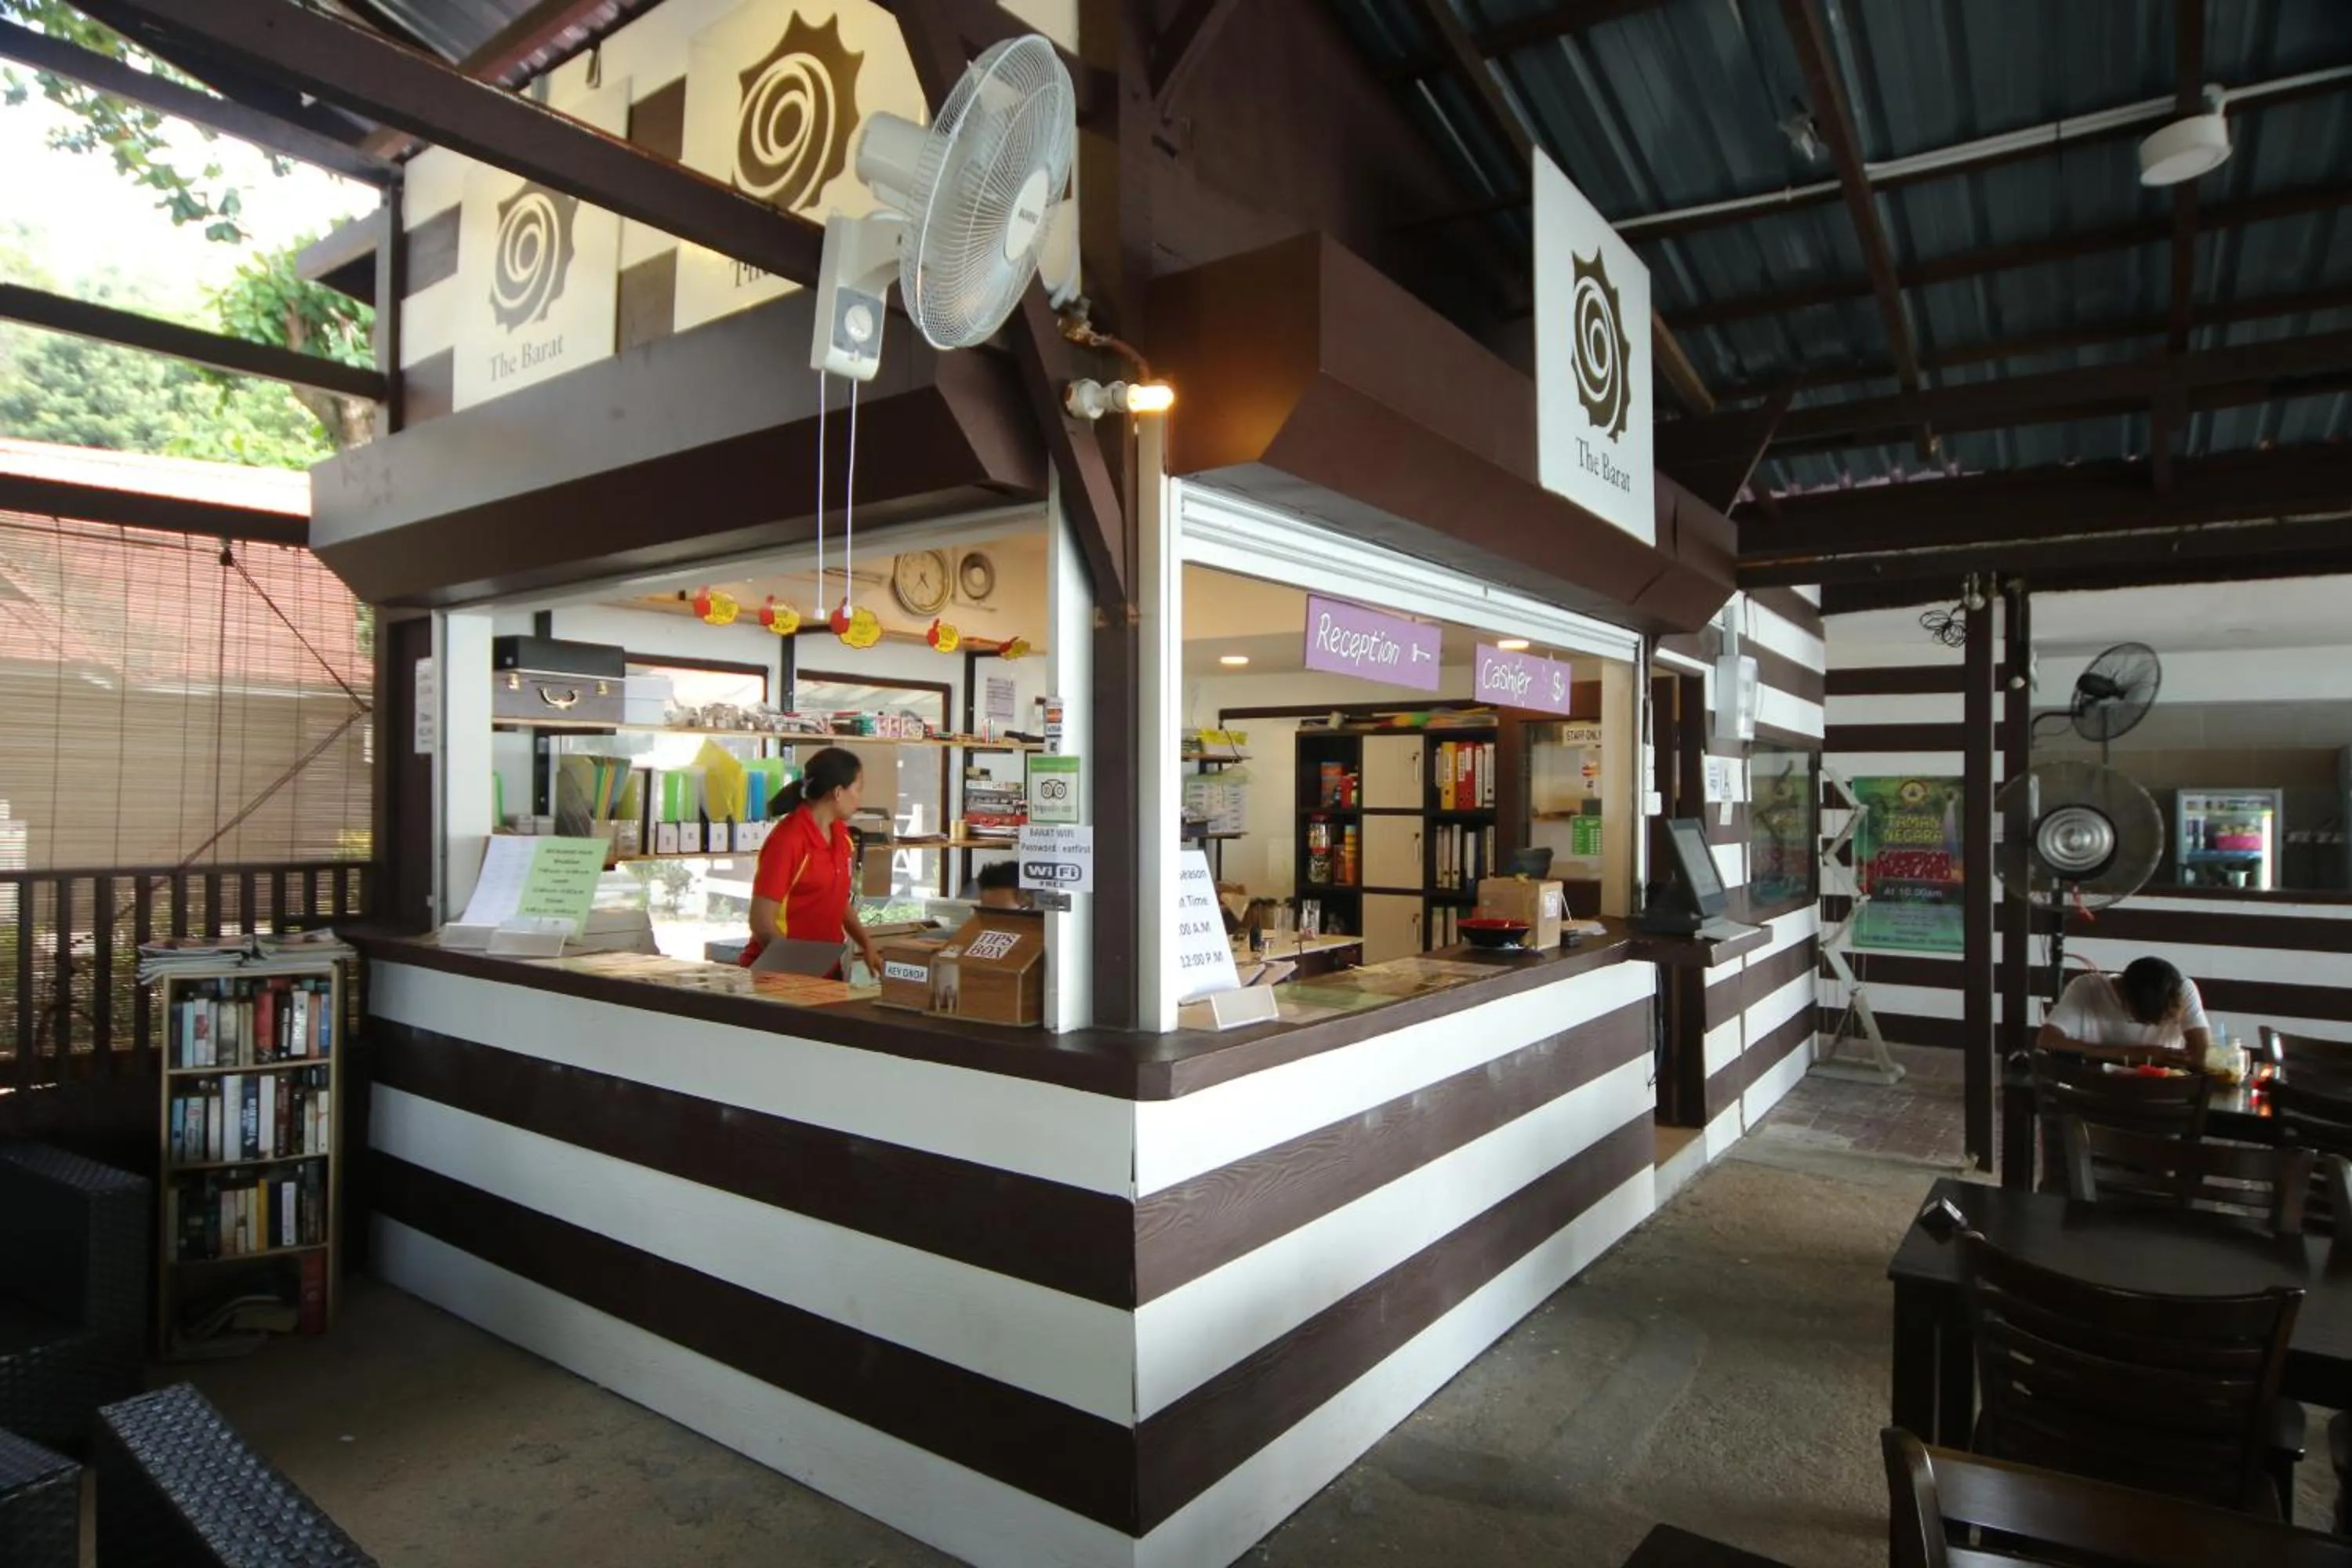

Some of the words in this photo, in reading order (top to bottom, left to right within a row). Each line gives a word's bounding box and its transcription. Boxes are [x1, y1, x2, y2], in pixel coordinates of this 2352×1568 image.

[729, 260, 769, 288] Th
[490, 351, 517, 382] The
[521, 333, 564, 368] Barat
[1575, 436, 1599, 475] The
[1602, 452, 1630, 493] Barat
[1316, 612, 1400, 666] Reception
[1482, 659, 1532, 695] Cashier
[1567, 729, 1584, 741] STAFF
[1886, 815, 1940, 829] TAMAN
[1029, 828, 1054, 837] BARAT
[1883, 829, 1944, 844] NEGARA
[1021, 843, 1056, 853] Password
[1883, 887, 1895, 895] At
[1186, 895, 1210, 906] Time
[982, 931, 1014, 947] TIPS
[969, 943, 1007, 959] BOX
[1180, 953, 1205, 968] 12:00
[887, 965, 902, 976] KEY
[902, 968, 925, 979] DROP
